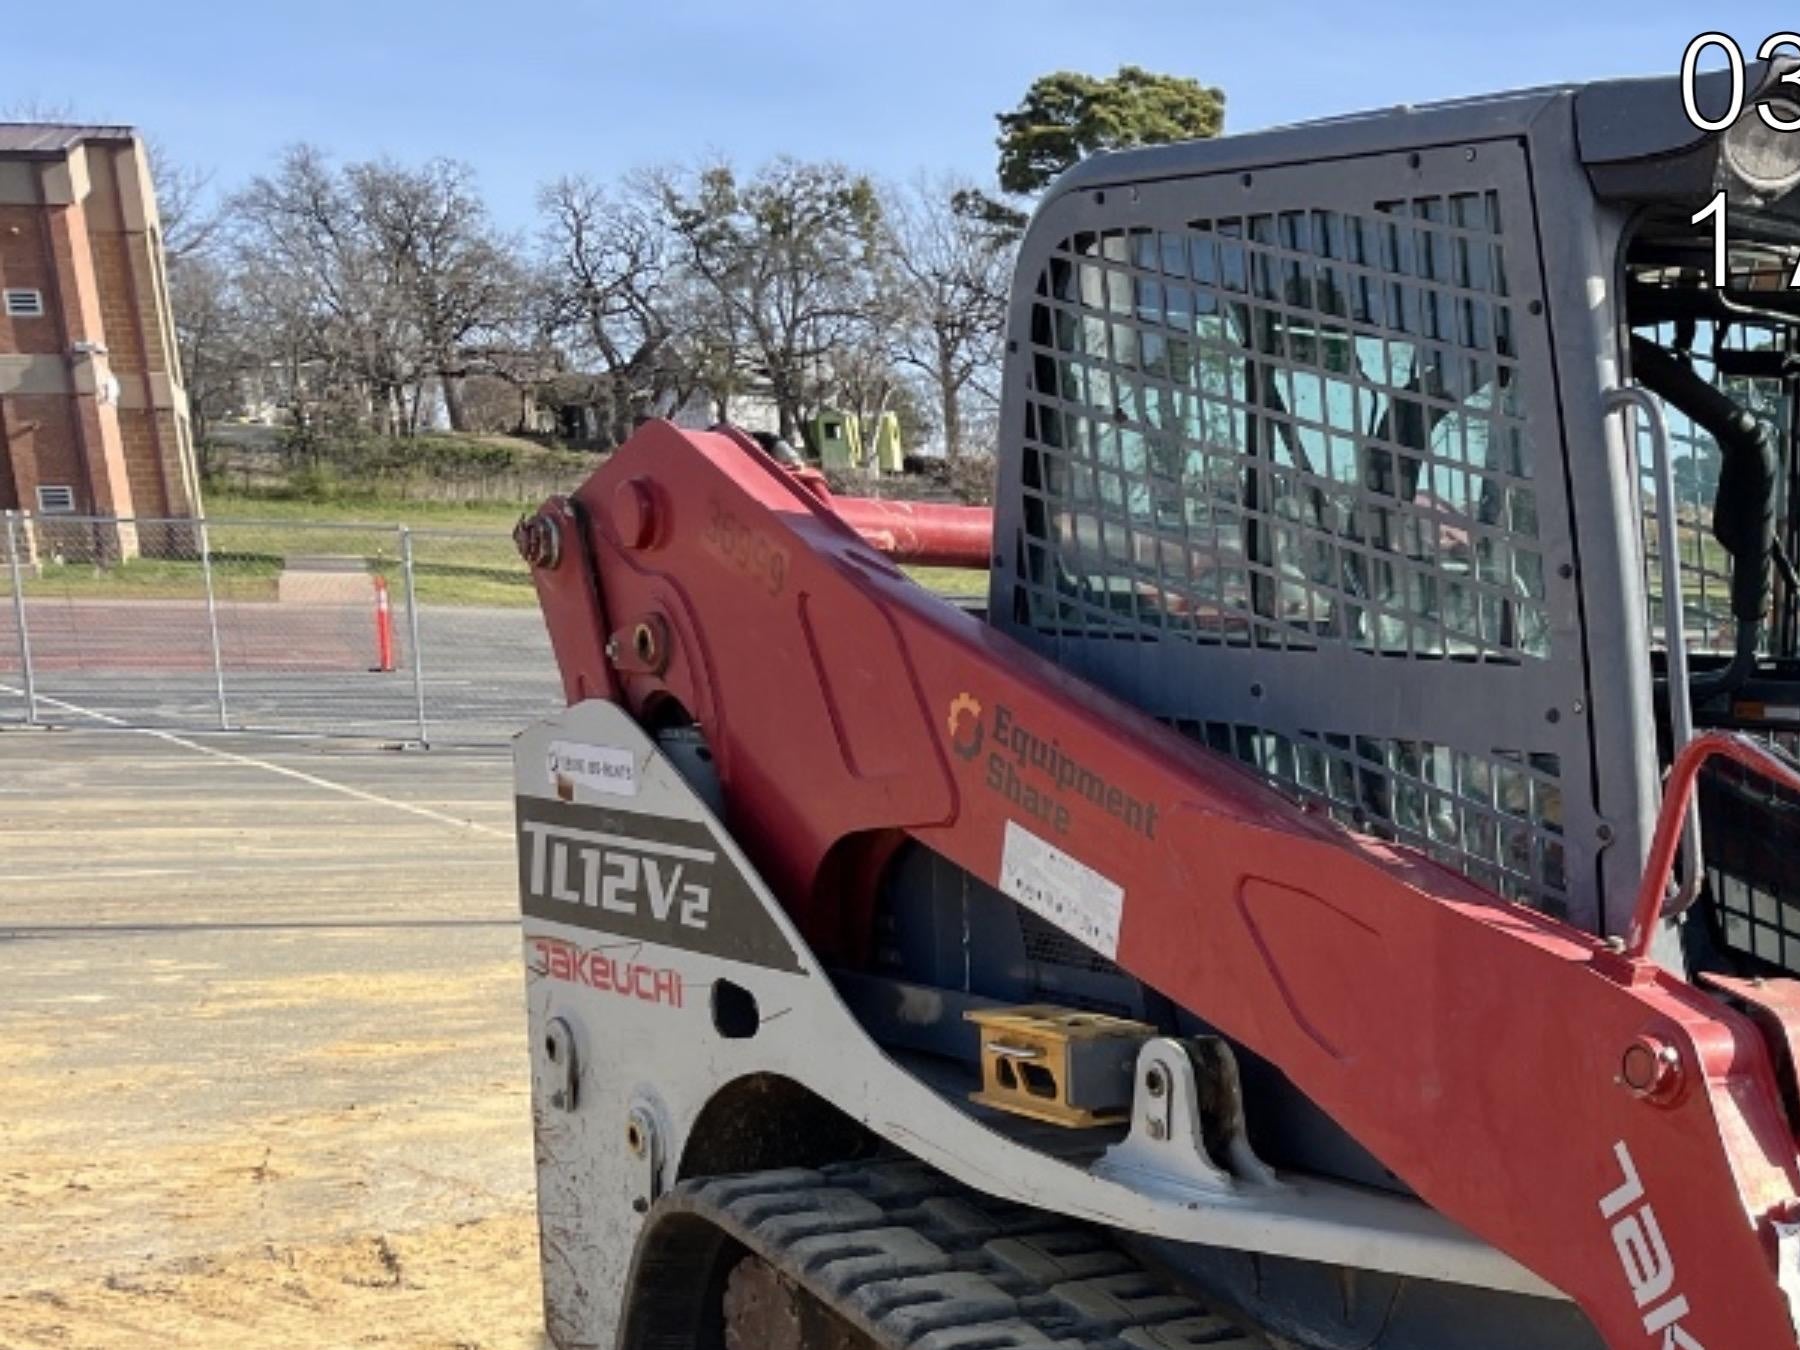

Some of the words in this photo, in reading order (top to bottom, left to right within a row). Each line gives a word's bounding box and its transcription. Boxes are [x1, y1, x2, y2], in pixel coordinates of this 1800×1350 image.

[985, 751, 1071, 835] Share
[992, 702, 1160, 840] Equipment
[521, 820, 716, 929] TL12V2
